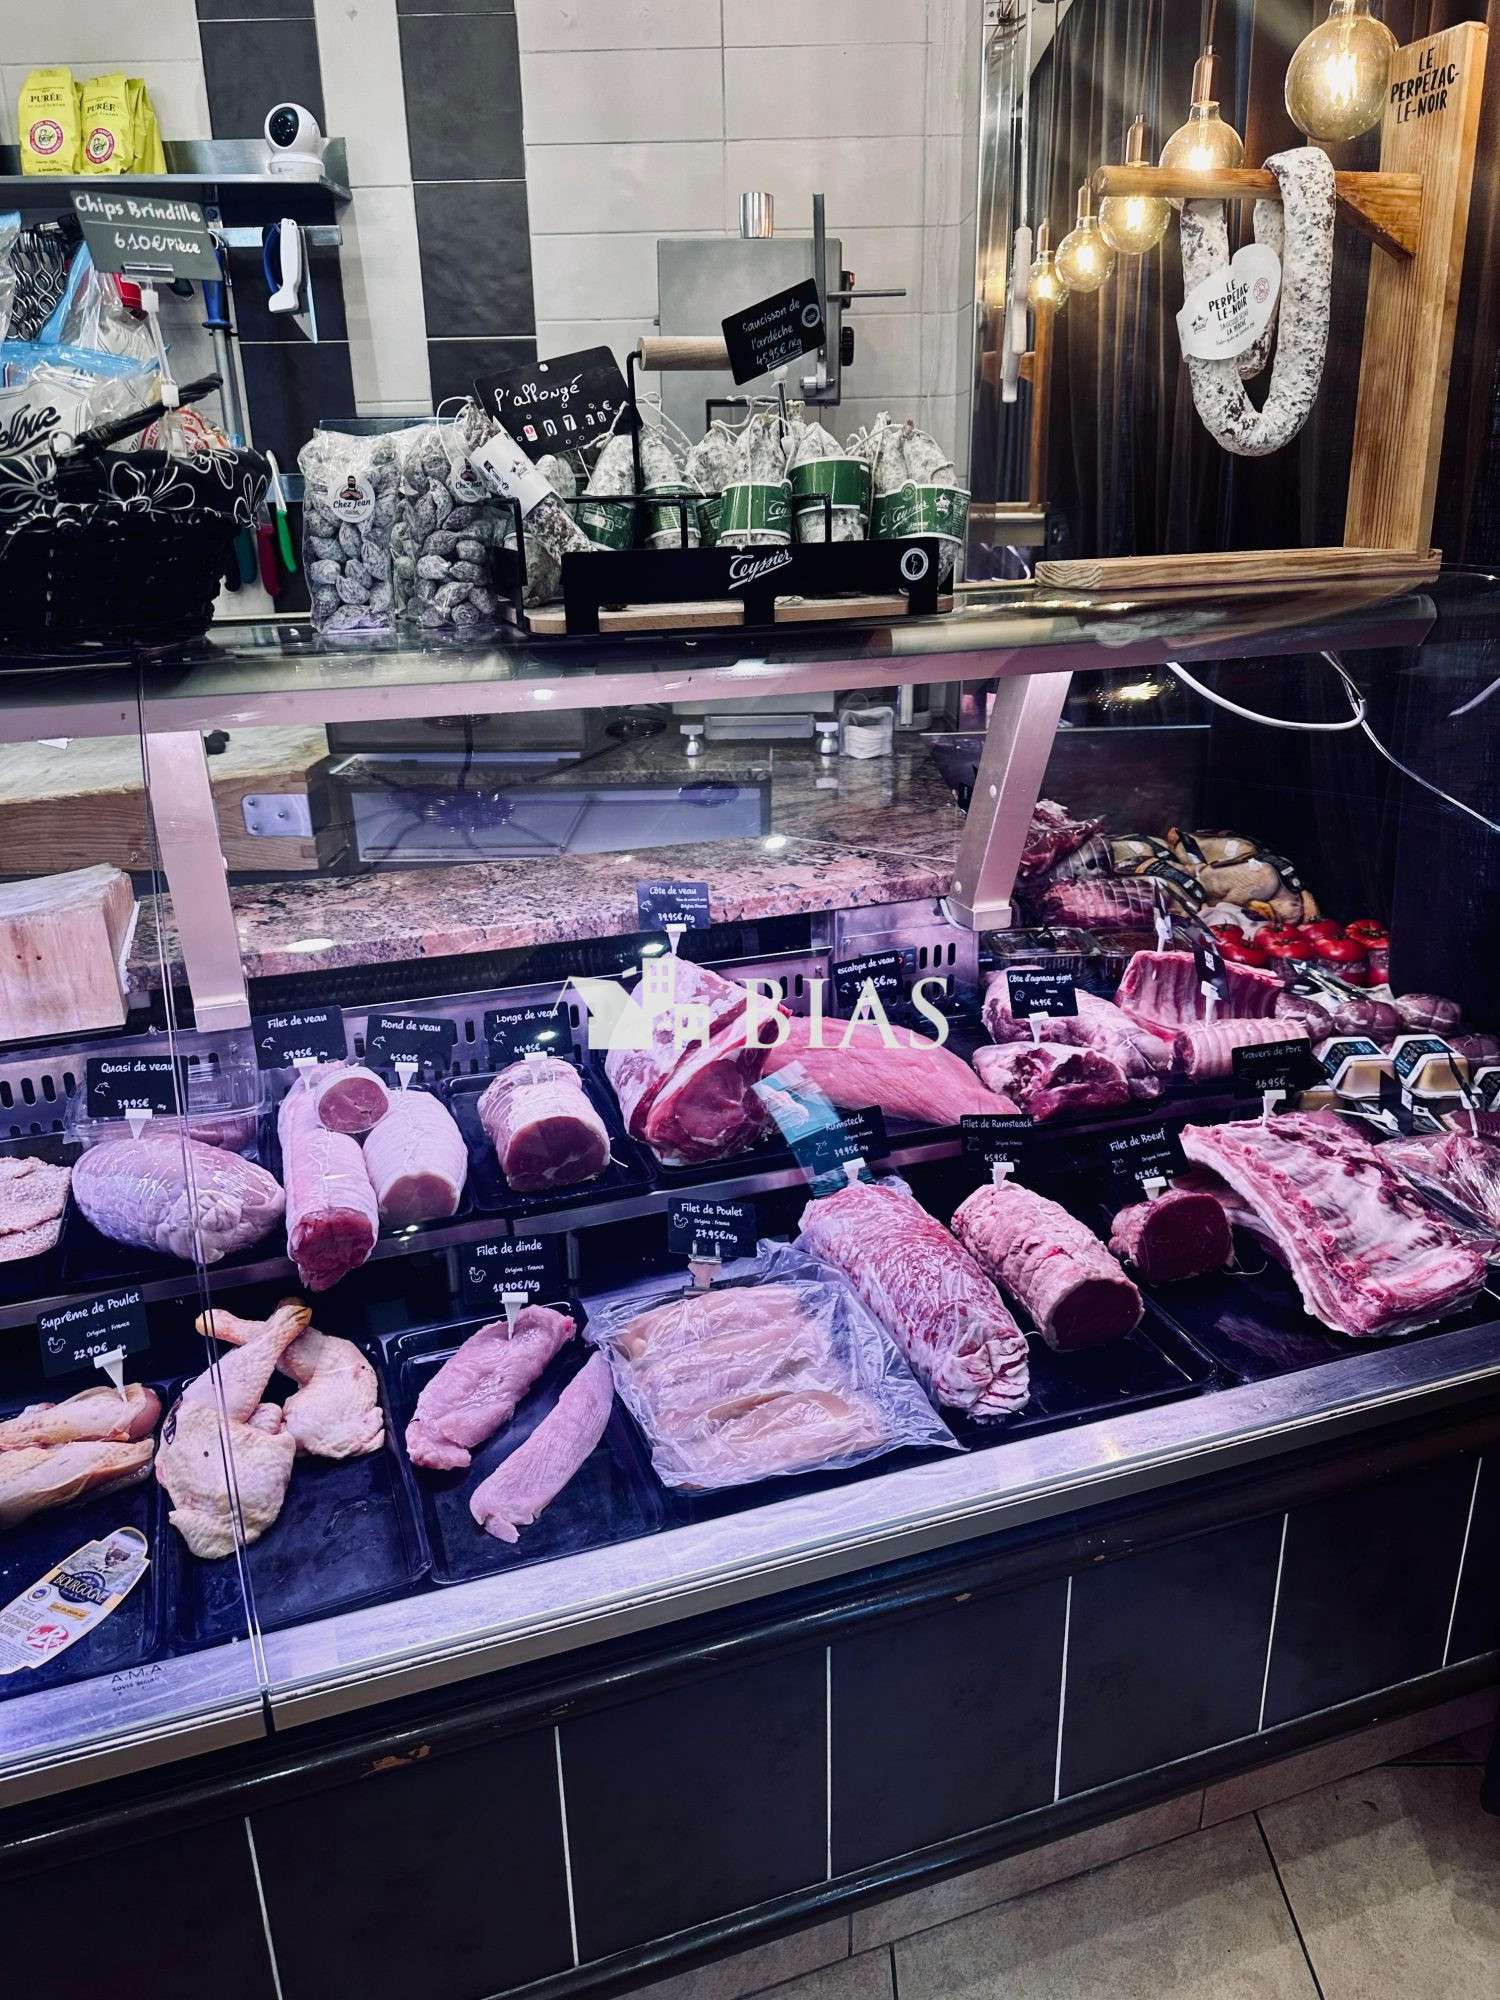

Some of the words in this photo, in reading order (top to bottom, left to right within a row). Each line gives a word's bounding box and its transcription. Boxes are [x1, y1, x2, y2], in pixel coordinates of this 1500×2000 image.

[1419, 48, 1435, 73] LE
[1390, 64, 1460, 104] PERPEZAC-
[1396, 90, 1448, 124] LE-NOIR
[75, 194, 124, 221] Chips
[127, 200, 200, 222] Brindille
[1226, 279, 1236, 293] LE
[789, 298, 800, 312] de
[1217, 296, 1248, 321] LE-NOIR
[333, 500, 352, 508] Chez
[352, 500, 370, 509] Jean
[728, 549, 792, 590] Teyssier
[668, 886, 678, 894] de
[838, 963, 867, 974] escalope
[868, 958, 877, 968] de
[878, 956, 895, 965] veau
[1056, 974, 1072, 984] gigot
[268, 1018, 288, 1028] Filet
[290, 1015, 302, 1026] de
[304, 1014, 327, 1024] veau
[496, 1014, 522, 1024] Longe
[524, 1010, 536, 1020] de
[536, 1010, 558, 1018] veau
[381, 1020, 404, 1030] Rond
[406, 1020, 417, 1030] de
[420, 1024, 440, 1032] veau
[1242, 1050, 1271, 1059] Travers
[1274, 1046, 1284, 1056] de
[101, 1062, 131, 1074] Quasi
[134, 1060, 147, 1072] de
[149, 1062, 174, 1072] veau
[962, 1120, 978, 1128] Filet
[980, 1118, 990, 1128] de
[1110, 1140, 1128, 1152] Filet
[1130, 1136, 1140, 1146] de
[1140, 1128, 1166, 1144] Boeuf
[680, 1202, 700, 1214] Filet
[702, 1204, 714, 1214] de
[716, 1205, 744, 1216] Poulet
[476, 1244, 498, 1256] Filet
[500, 1242, 513, 1254] de
[516, 1239, 542, 1252] dinde
[40, 1308, 88, 1331] Suprême
[92, 1302, 105, 1316] de
[108, 1292, 140, 1310] Poulet
[54, 1574, 106, 1602] BOURGOGNE
